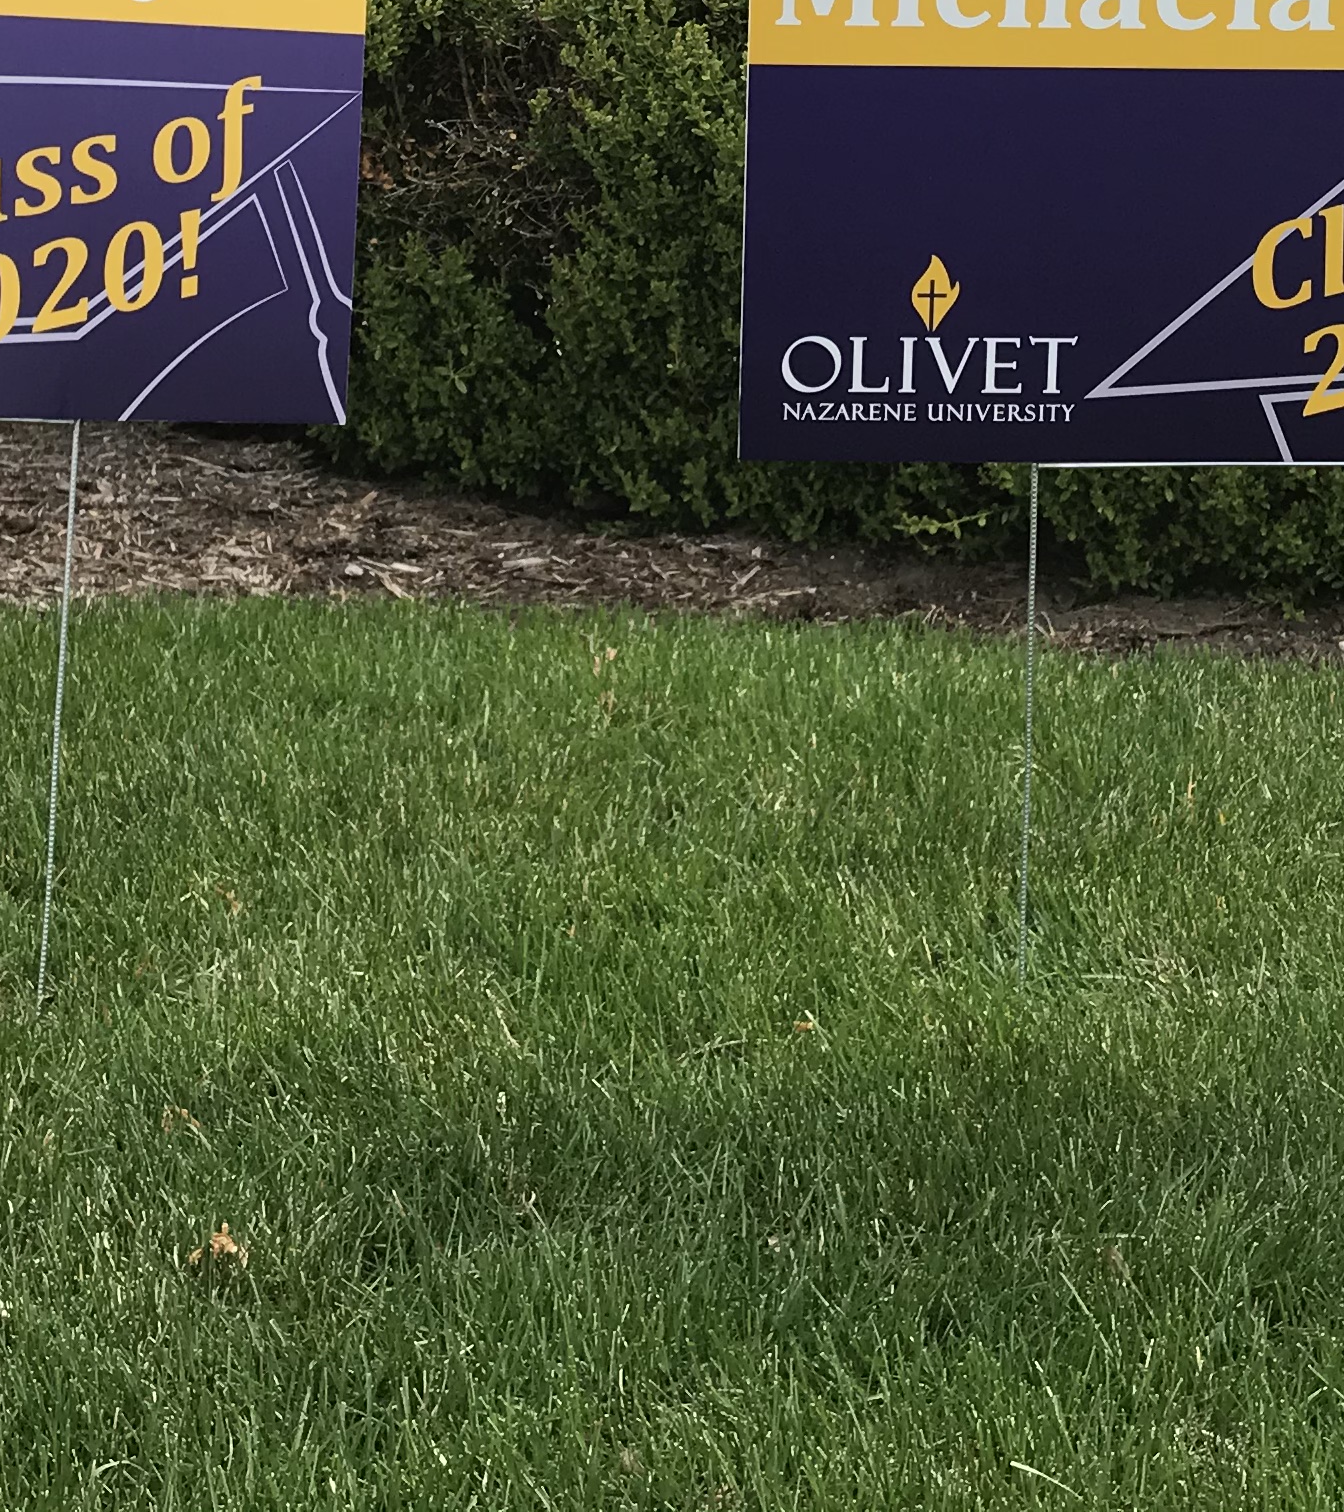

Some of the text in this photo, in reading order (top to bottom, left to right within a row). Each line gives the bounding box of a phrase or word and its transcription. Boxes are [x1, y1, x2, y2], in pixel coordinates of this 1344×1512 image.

[152, 75, 262, 203] of
[780, 334, 1080, 396] OLIVET
[781, 401, 1076, 423] NAZARENE UNIVERSITY
